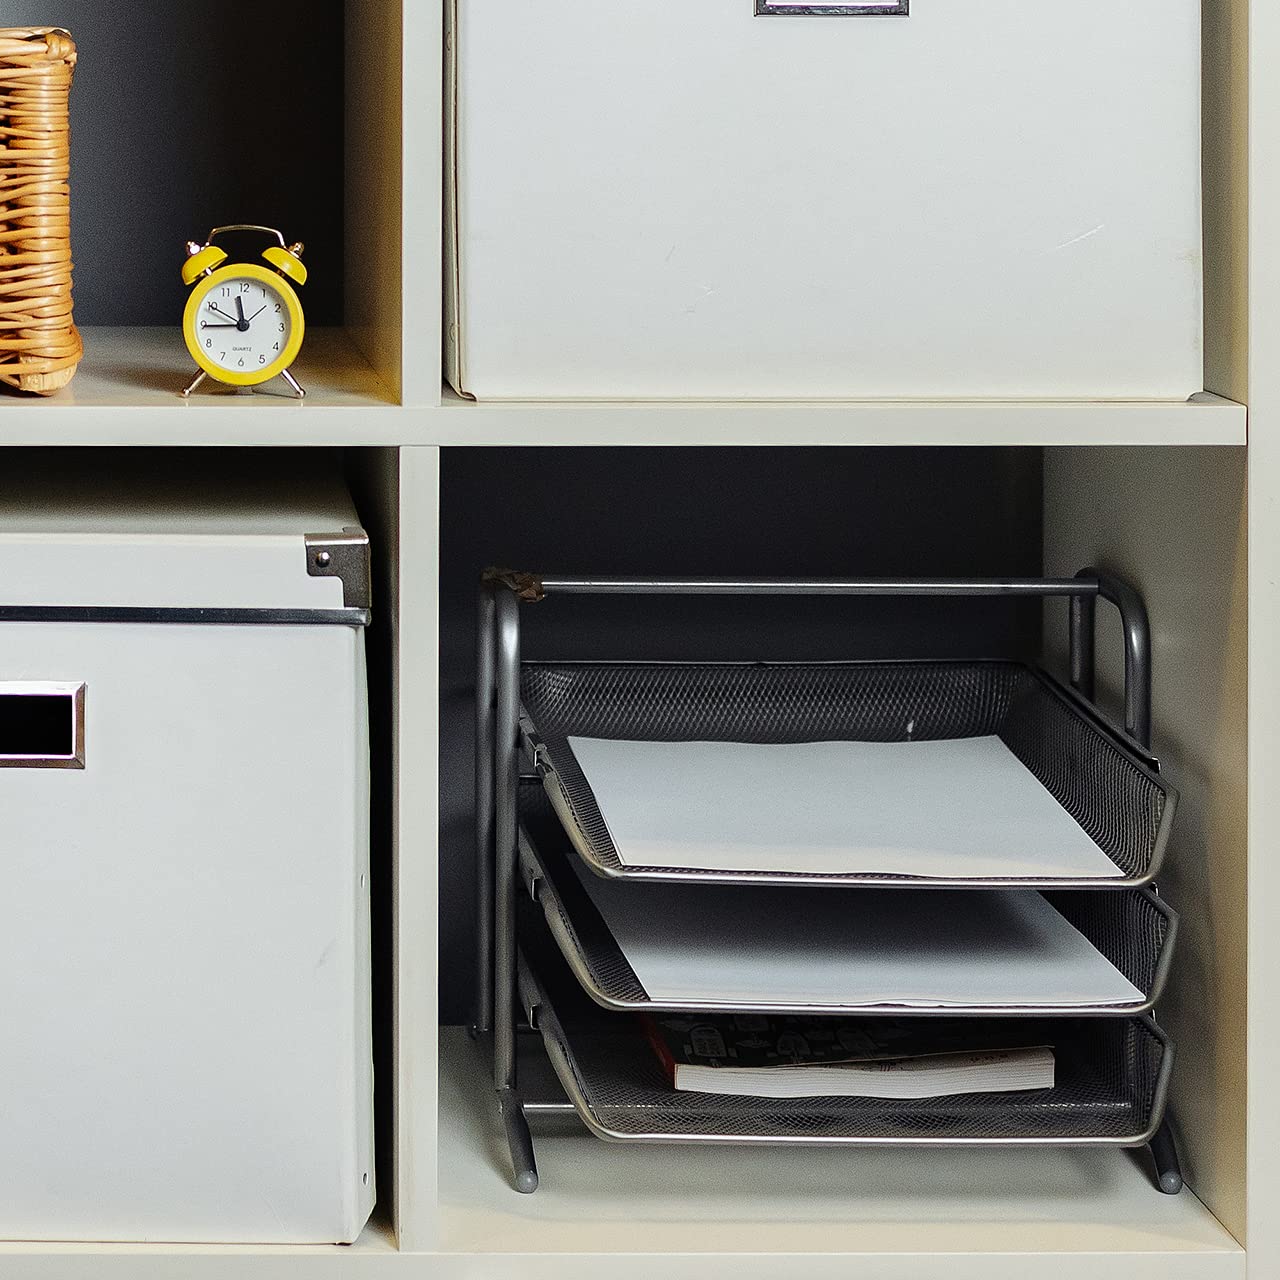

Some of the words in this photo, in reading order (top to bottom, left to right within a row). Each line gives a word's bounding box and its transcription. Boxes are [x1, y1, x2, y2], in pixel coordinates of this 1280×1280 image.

[221, 288, 230, 297] 11
[239, 283, 250, 293] 12
[207, 301, 218, 311] 10
[274, 304, 281, 313] 2
[200, 319, 207, 330] 9
[278, 323, 285, 332] 3
[206, 339, 212, 348] 8
[273, 342, 279, 351] 4
[221, 352, 225, 361] 7
[259, 355, 265, 364] 5
[238, 358, 245, 367] 6
